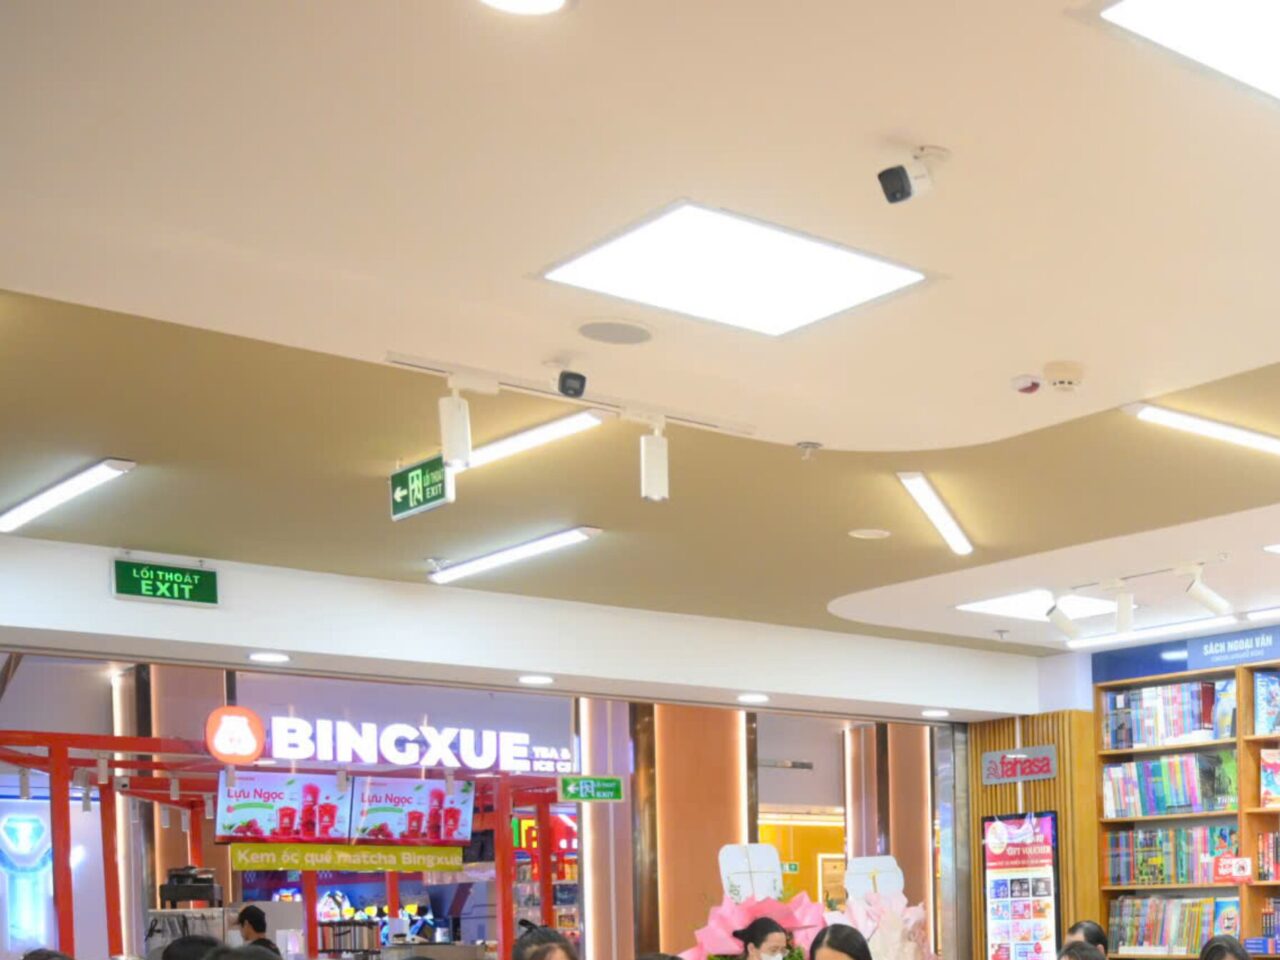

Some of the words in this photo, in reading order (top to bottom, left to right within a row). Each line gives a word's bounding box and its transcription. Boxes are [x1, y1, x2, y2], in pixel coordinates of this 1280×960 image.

[133, 566, 154, 579] LỐI
[156, 570, 200, 584] THOÁT
[141, 580, 193, 599] EXIT
[1203, 641, 1226, 656] SÁCH
[271, 716, 531, 771] BINGXUE
[1000, 754, 1052, 779] fahasa
[237, 850, 276, 864] Kem
[337, 850, 396, 865] matcha
[402, 852, 462, 869] Bingxue
